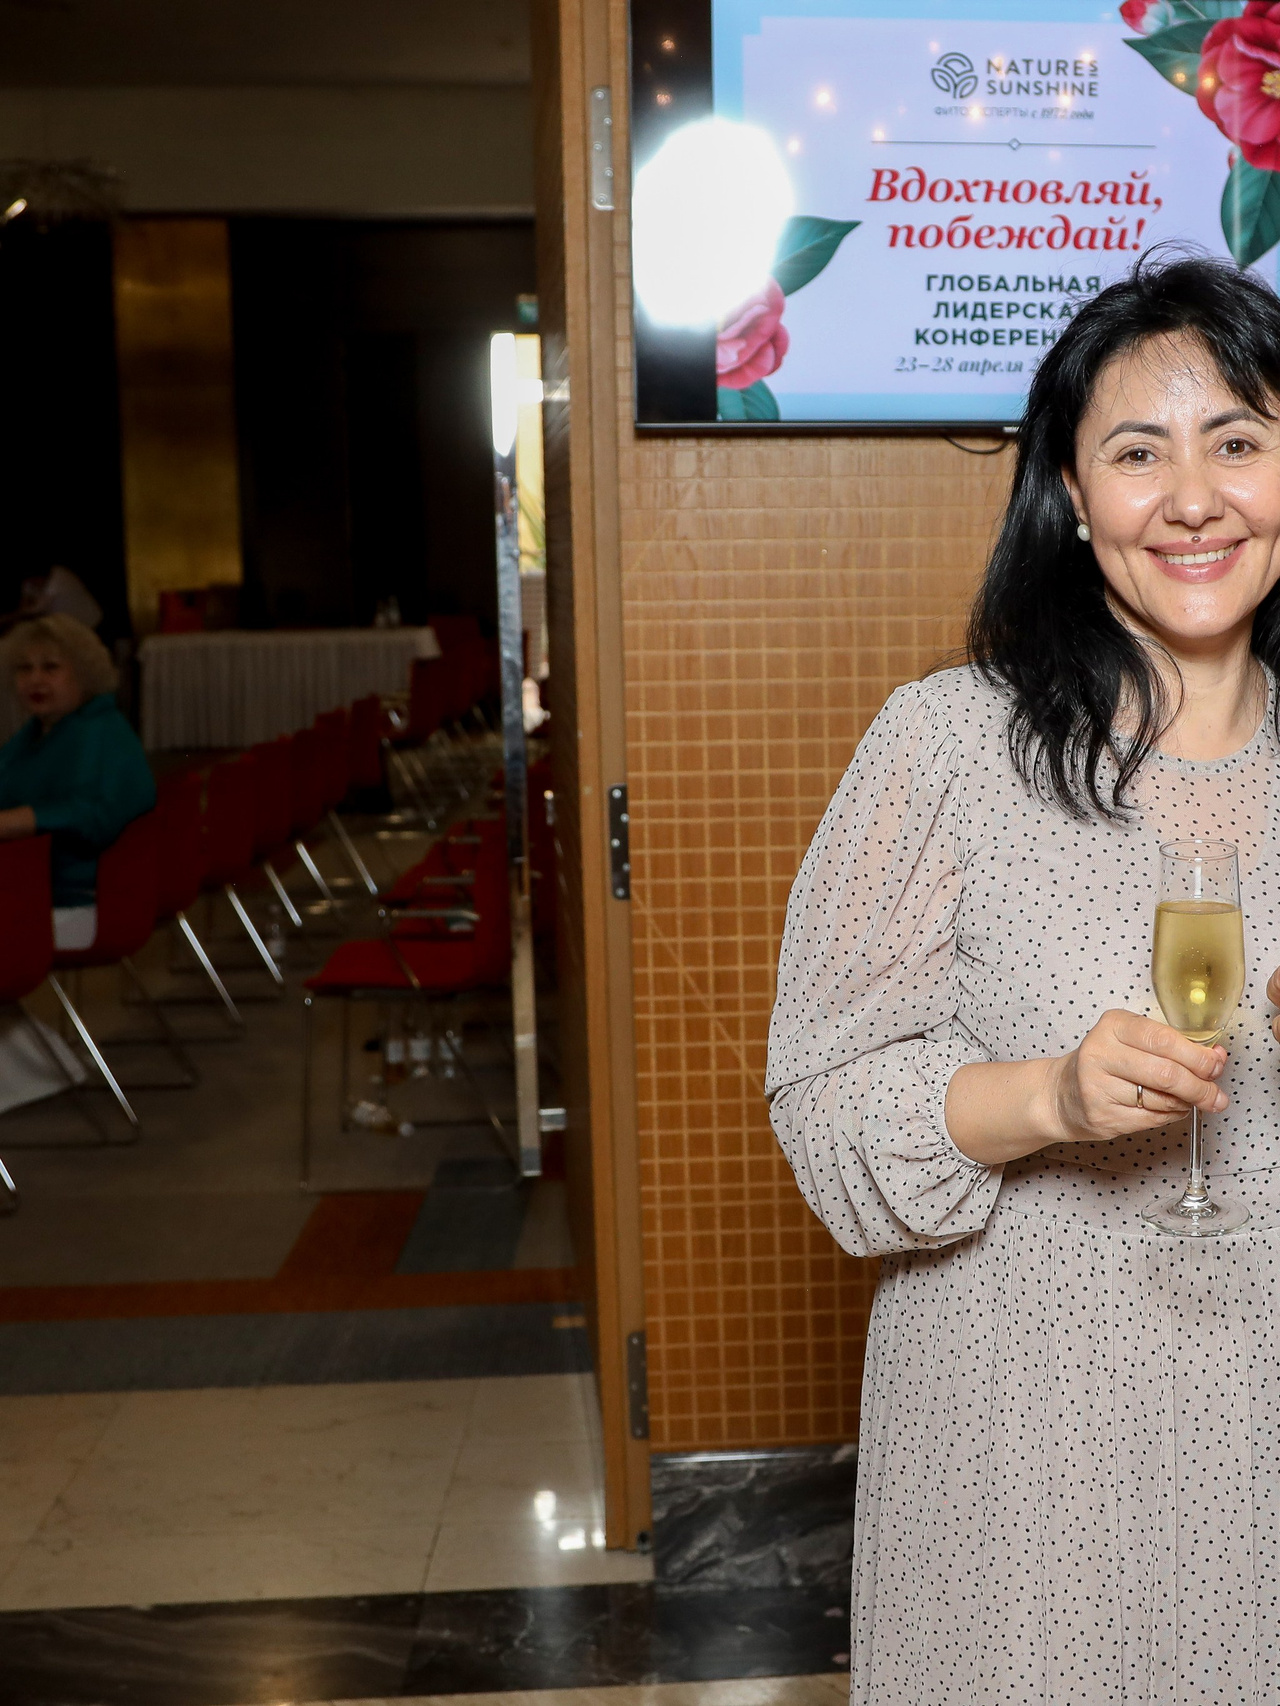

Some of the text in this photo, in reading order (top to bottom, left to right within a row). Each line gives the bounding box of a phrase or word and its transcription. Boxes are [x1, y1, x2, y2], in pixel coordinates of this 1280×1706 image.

[986, 58, 1099, 77] NATURES
[986, 79, 1099, 97] SUNSHINE
[866, 166, 1163, 214] Вдохновляй,
[887, 214, 1147, 251] побеждай!
[926, 274, 1101, 293] ГЛОБАЛЬНАЯ
[932, 302, 1076, 322] ЛИДЕРСКА
[914, 328, 1058, 347] КОНФЕРЕН
[959, 358, 1024, 376] апреля
